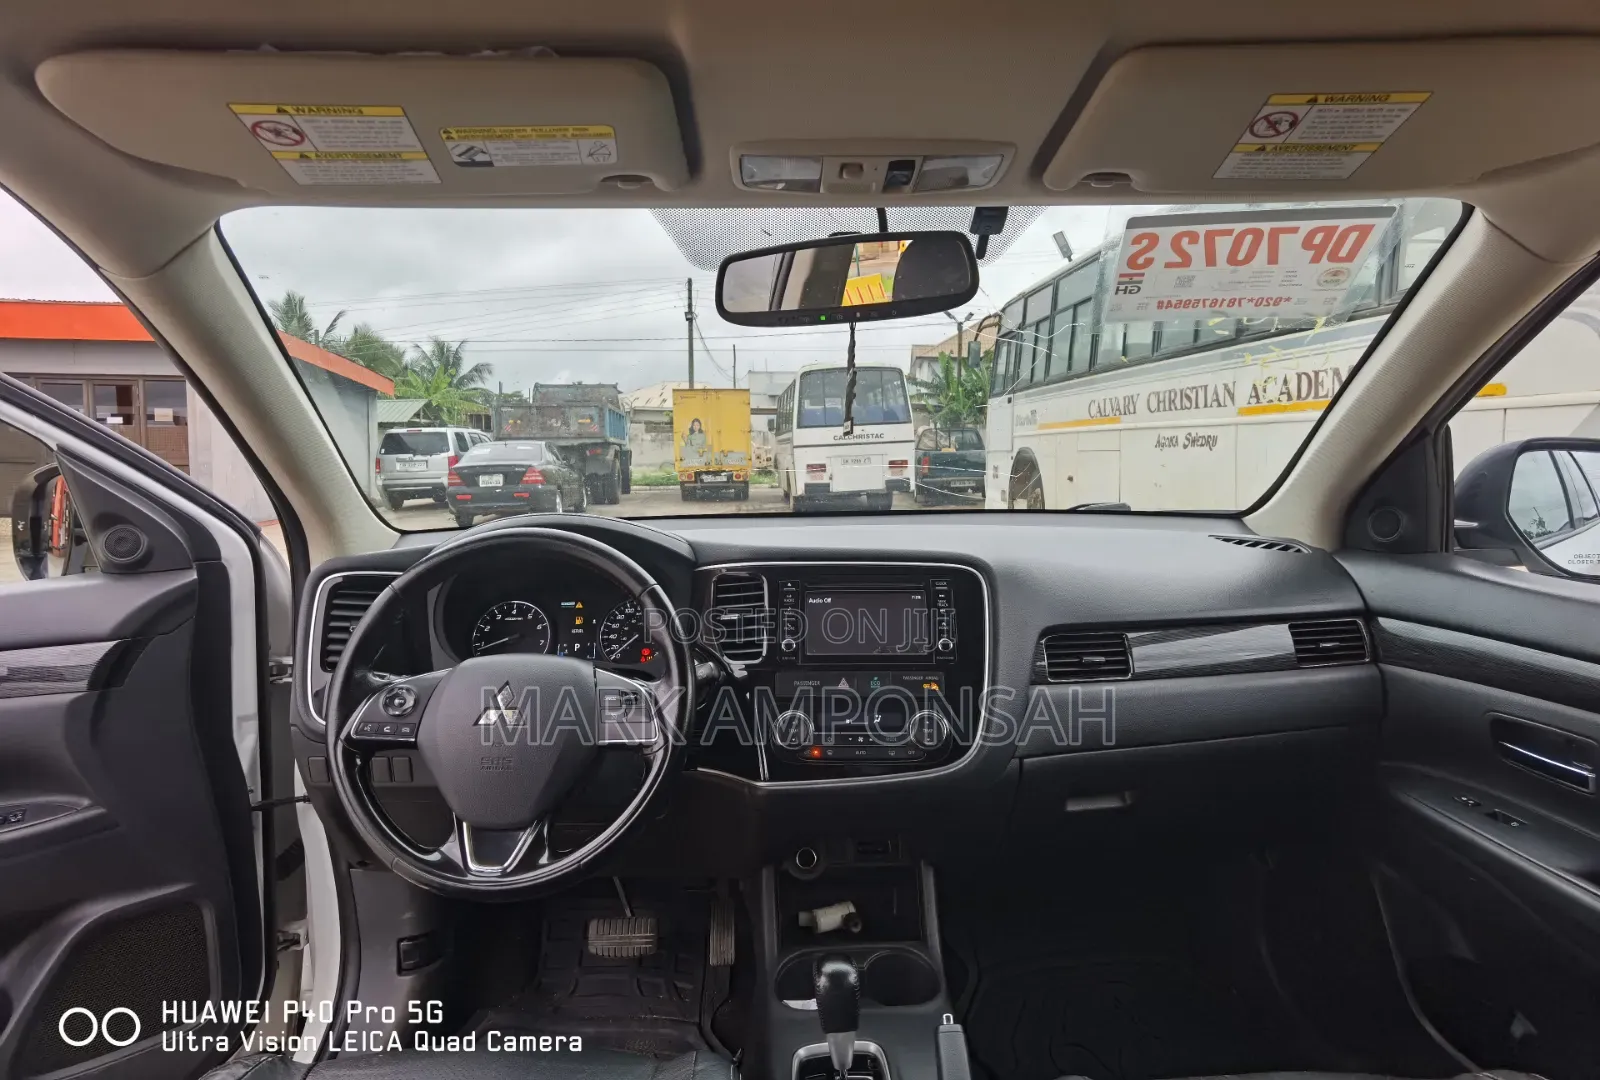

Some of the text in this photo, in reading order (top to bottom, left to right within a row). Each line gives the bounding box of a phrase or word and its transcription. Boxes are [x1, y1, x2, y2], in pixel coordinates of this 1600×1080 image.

[1324, 94, 1392, 103] WARNING
[292, 106, 364, 115] WARNING
[1088, 393, 1140, 419] CALVARY
[1146, 381, 1237, 414] CHRISTIAN
[574, 643, 580, 652] P
